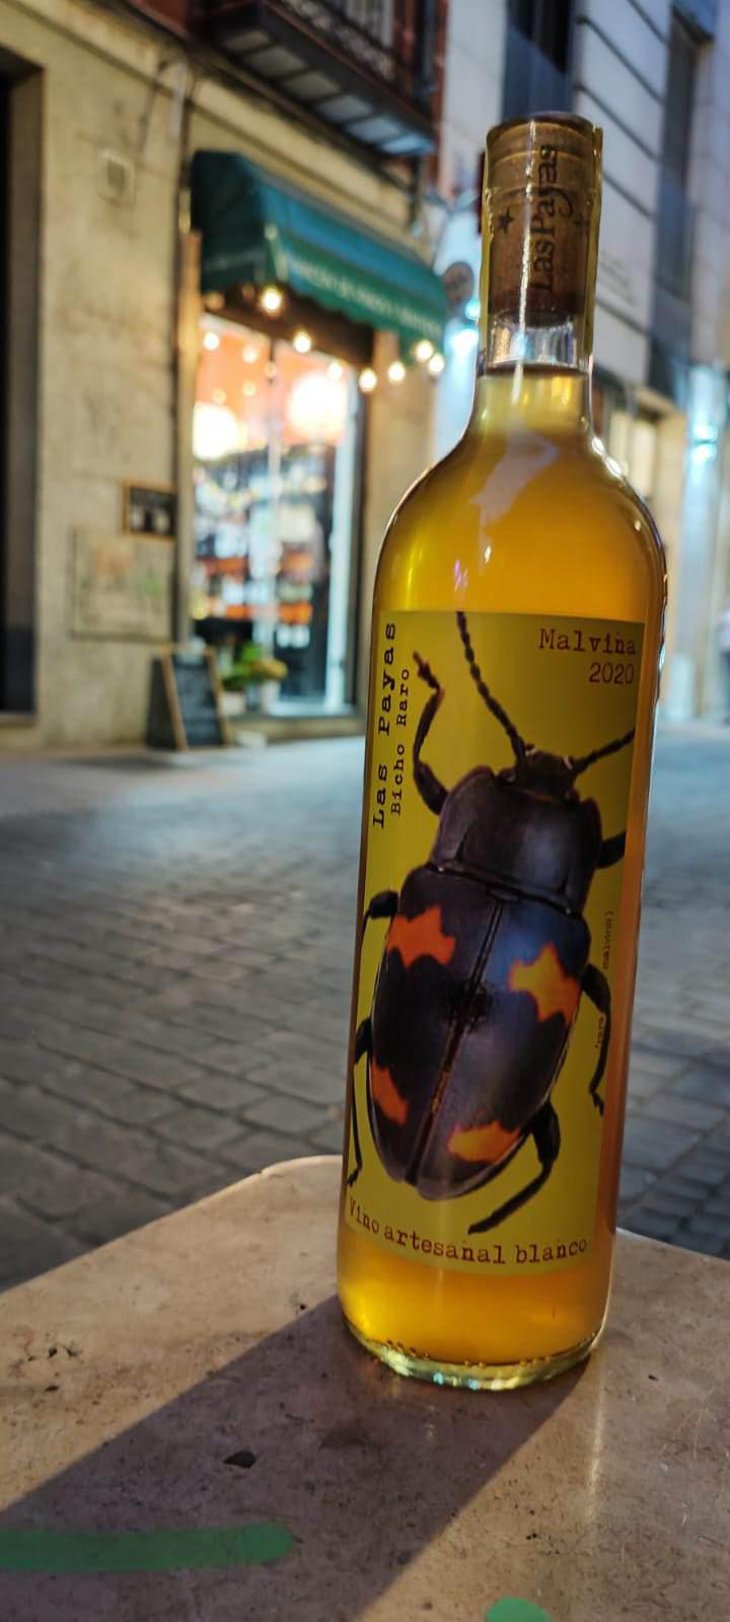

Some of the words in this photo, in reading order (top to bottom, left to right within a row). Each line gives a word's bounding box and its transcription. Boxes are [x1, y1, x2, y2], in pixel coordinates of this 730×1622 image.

[538, 627, 636, 655] Malvina
[588, 661, 635, 685] 2020
[378, 622, 396, 737] Payas
[396, 668, 410, 727] Raro
[373, 763, 388, 829] Las
[391, 743, 405, 816] Bicho
[349, 1196, 381, 1235] Vino
[383, 1225, 506, 1265] artesanal
[515, 1237, 588, 1265] blanco
